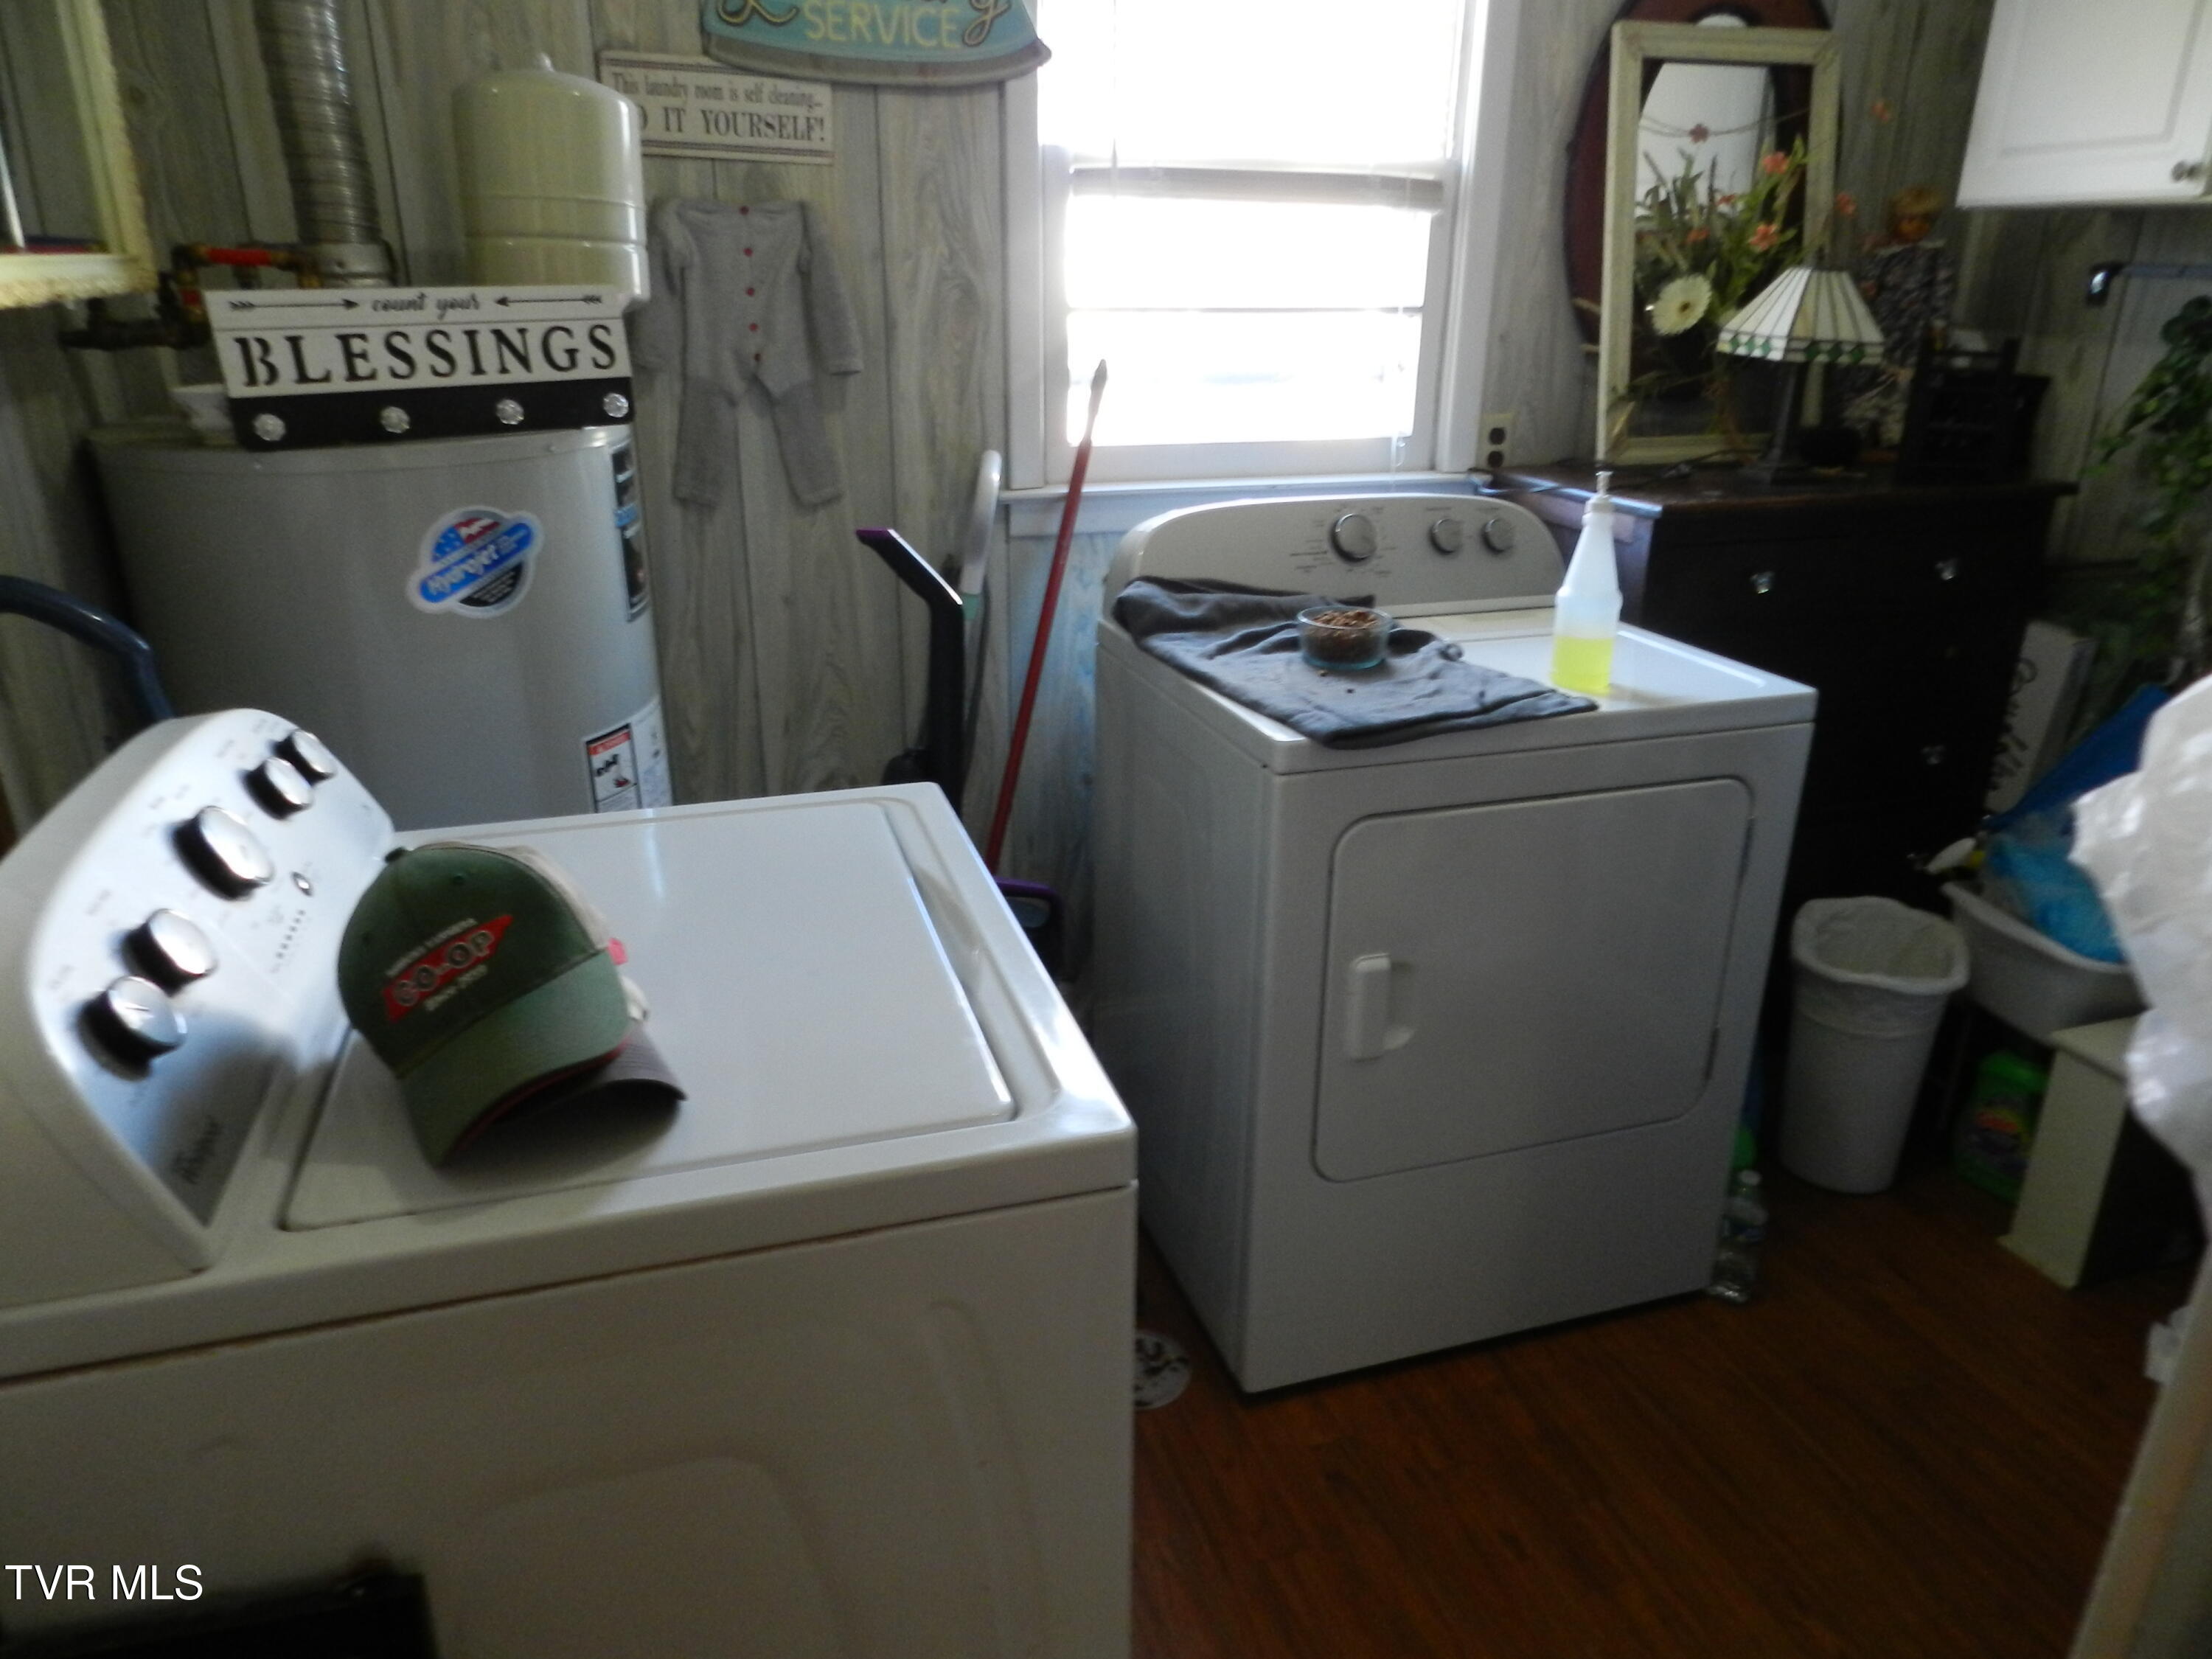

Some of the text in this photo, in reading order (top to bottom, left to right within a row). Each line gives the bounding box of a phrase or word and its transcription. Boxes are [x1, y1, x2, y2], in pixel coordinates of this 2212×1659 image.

[803, 3, 959, 48] SERVICE
[611, 72, 639, 94] This
[644, 73, 687, 101] laundry
[694, 85, 723, 100] room
[728, 81, 740, 101] is
[744, 82, 765, 102] self
[664, 105, 686, 133] IT
[700, 108, 825, 142] YOURSELF!
[372, 292, 480, 320] count your
[234, 323, 617, 388] BLESSINGS
